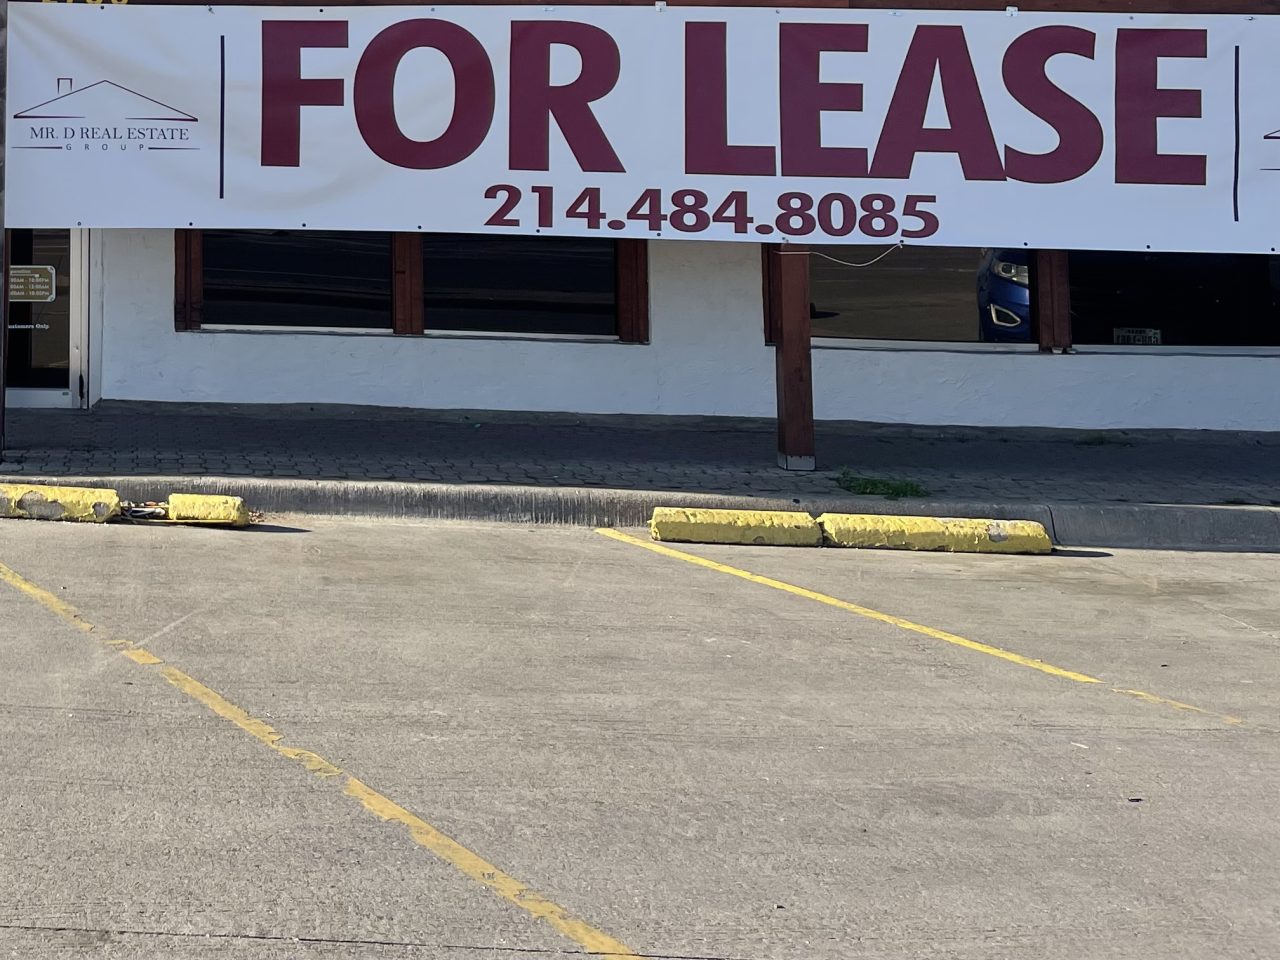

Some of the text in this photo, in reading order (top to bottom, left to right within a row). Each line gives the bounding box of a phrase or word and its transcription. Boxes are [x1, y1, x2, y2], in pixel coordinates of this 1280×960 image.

[261, 17, 1207, 187] FOR LEASE
[30, 126, 190, 141] MR. D REAL ESTATE
[484, 183, 940, 239] 214.484.8085
